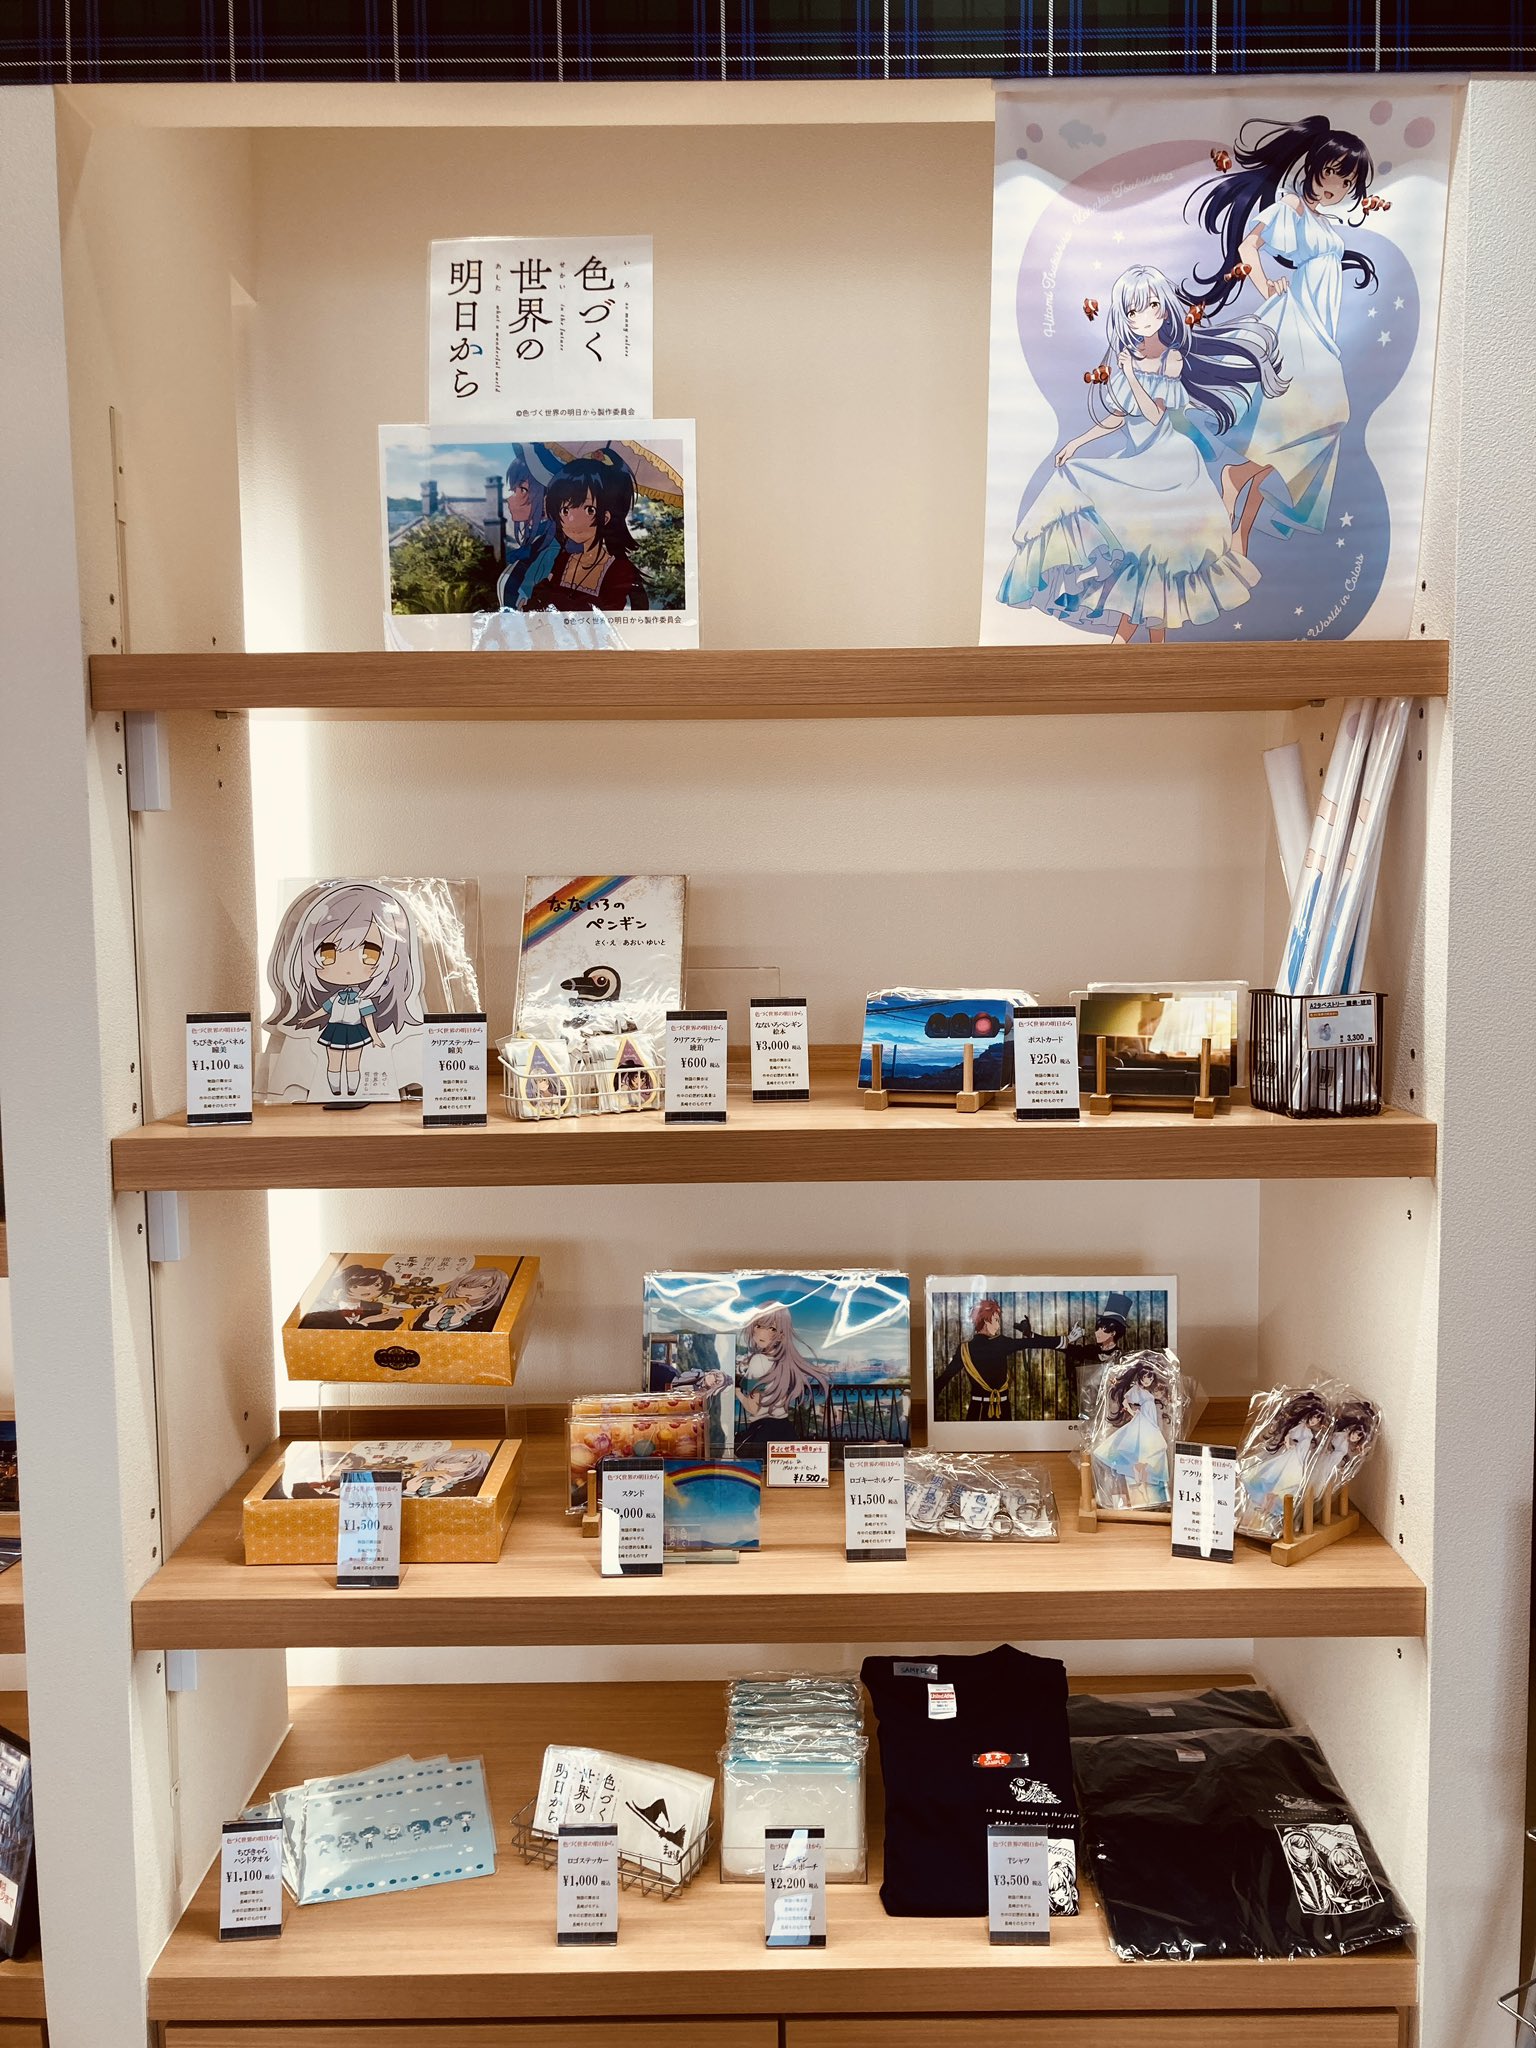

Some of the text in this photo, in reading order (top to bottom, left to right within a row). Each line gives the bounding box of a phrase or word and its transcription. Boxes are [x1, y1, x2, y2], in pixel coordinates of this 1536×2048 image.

[508, 258, 553, 360] 世界の
[574, 255, 616, 362] 色づく
[448, 259, 483, 398] 明日から
[1307, 553, 1364, 636] World in Colors
[547, 896, 625, 912] なないろの
[586, 917, 647, 931] ペンギン
[756, 1041, 789, 1051] ¥3,000
[681, 1057, 707, 1068] ¥600
[1030, 1054, 1057, 1064] ¥250
[192, 1060, 230, 1071] ¥1,100
[439, 1060, 466, 1071] ¥600
[850, 1476, 900, 1484] ロゴキーホルダー
[850, 1494, 885, 1506] ¥1,500
[344, 1520, 380, 1531] ¥1,500
[548, 1763, 569, 1823] 明日から
[599, 1773, 616, 1822] 色づく
[237, 1848, 268, 1856] ちびきゃら
[234, 1856, 270, 1864] ハンドタオル
[226, 1869, 262, 1883] ¥1,100
[563, 1875, 598, 1887] ¥1,000
[994, 1875, 1029, 1886] ¥3,500
[770, 1878, 806, 1890] ¥2,200
